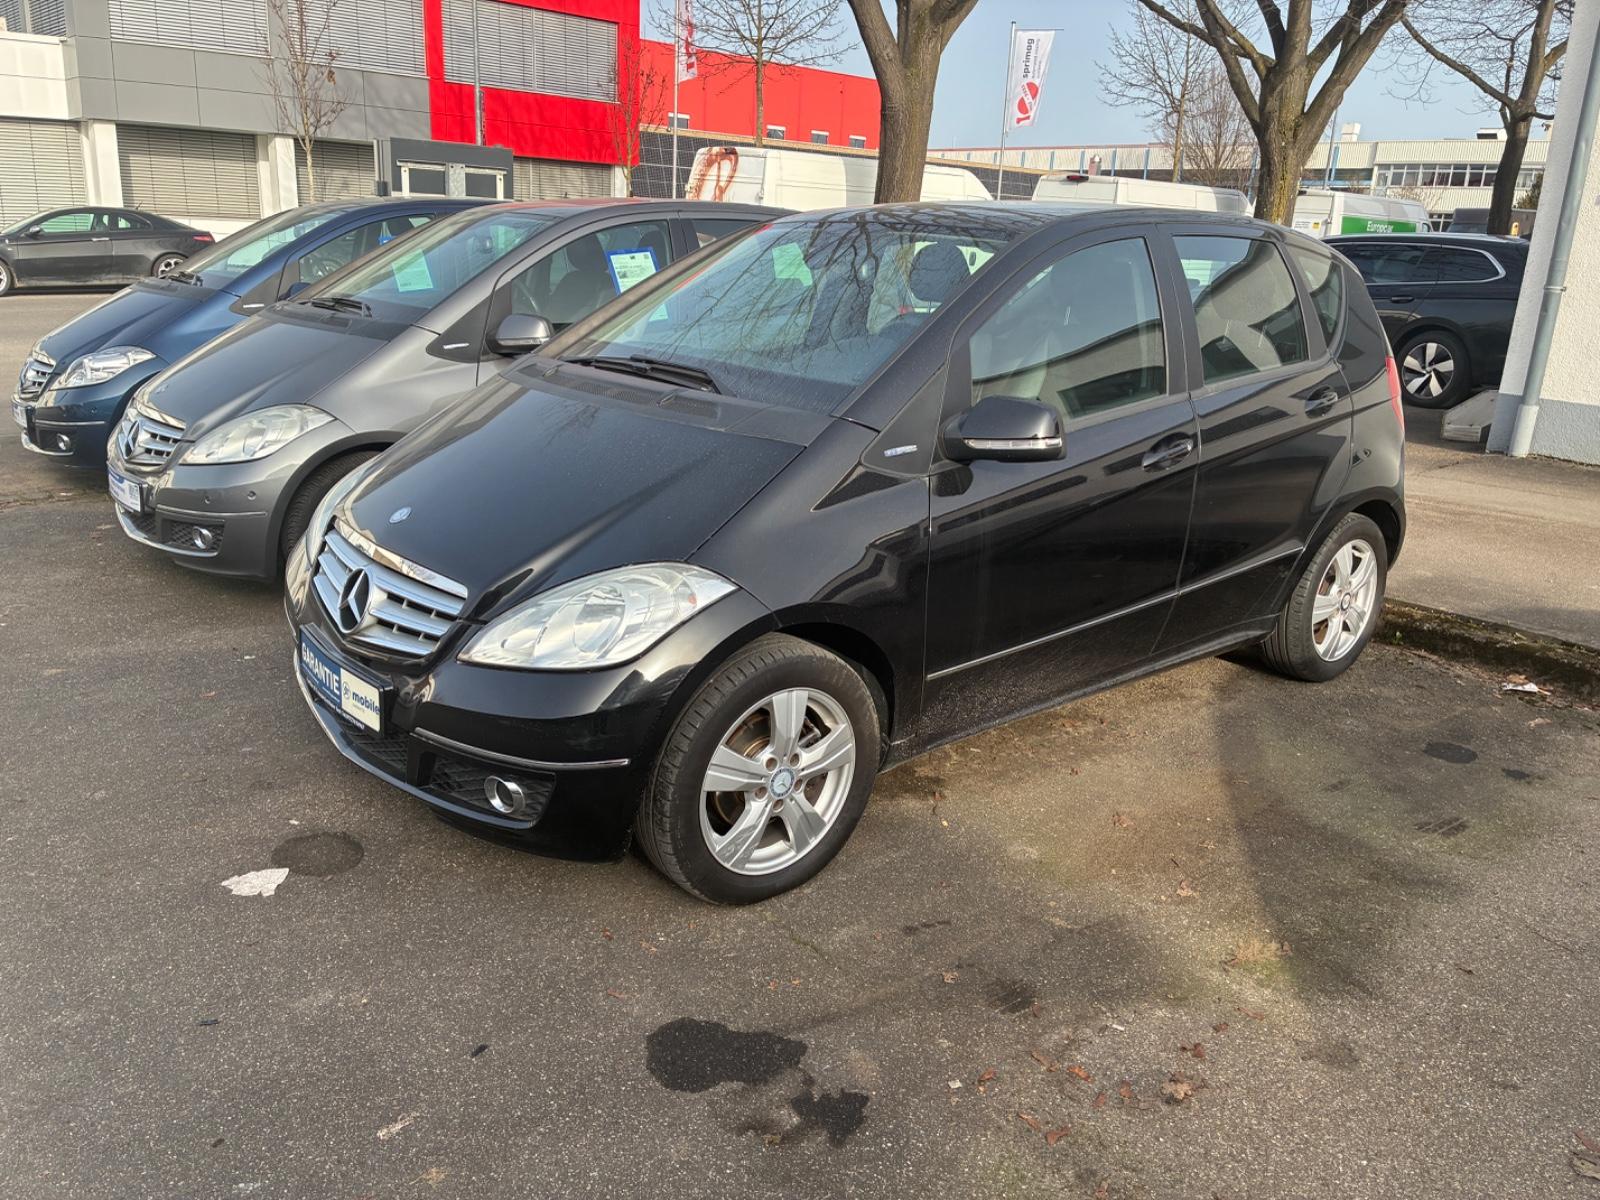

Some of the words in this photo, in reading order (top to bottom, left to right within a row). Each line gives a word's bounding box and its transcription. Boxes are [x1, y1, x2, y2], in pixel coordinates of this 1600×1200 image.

[1366, 220, 1394, 233] Europcar
[302, 642, 340, 695] GARANTIE
[352, 691, 380, 715] mobile
